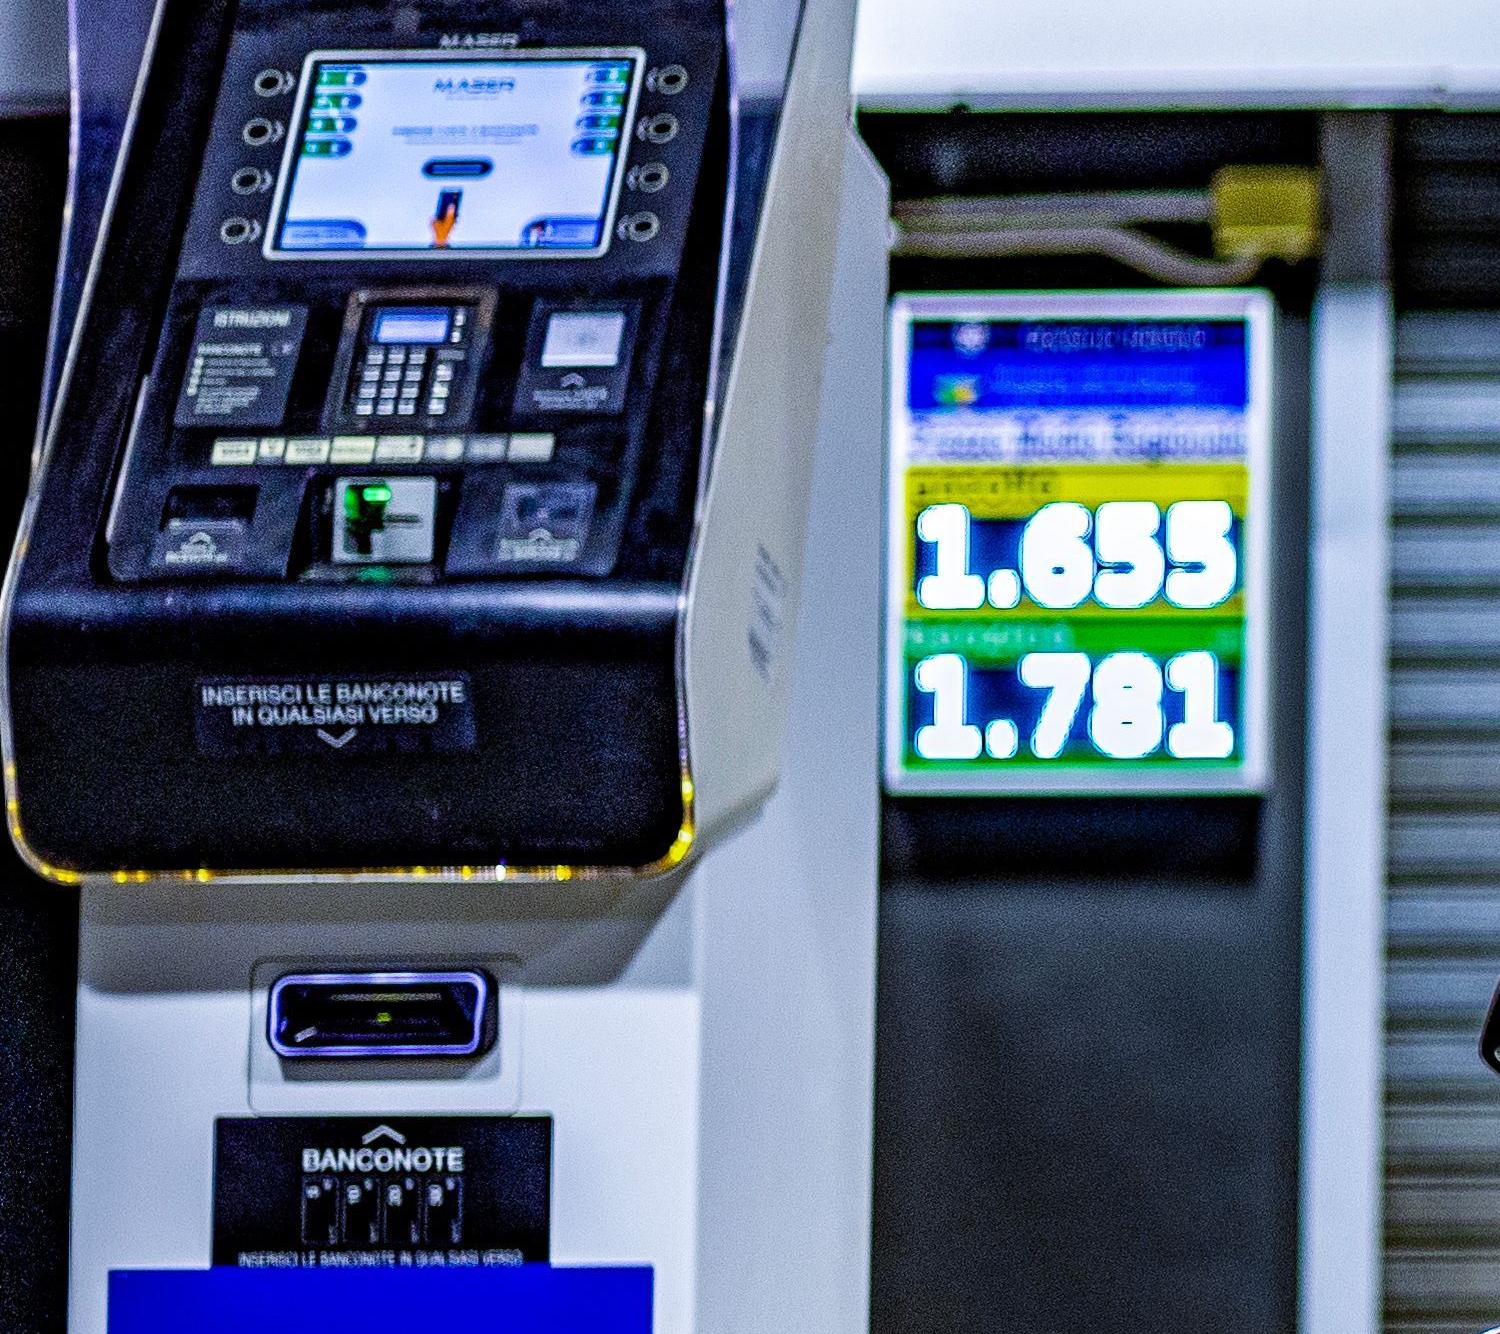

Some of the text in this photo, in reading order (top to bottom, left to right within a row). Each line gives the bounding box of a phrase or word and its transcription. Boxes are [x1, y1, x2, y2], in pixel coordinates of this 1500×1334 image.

[915, 500, 1238, 610] 1.655
[201, 680, 465, 707] INSERISCI LE BANCONOTE
[914, 649, 1235, 761] 1.781
[231, 703, 438, 726] IN QUALSIASI VERSO
[302, 1147, 465, 1173] BANCONOTE
